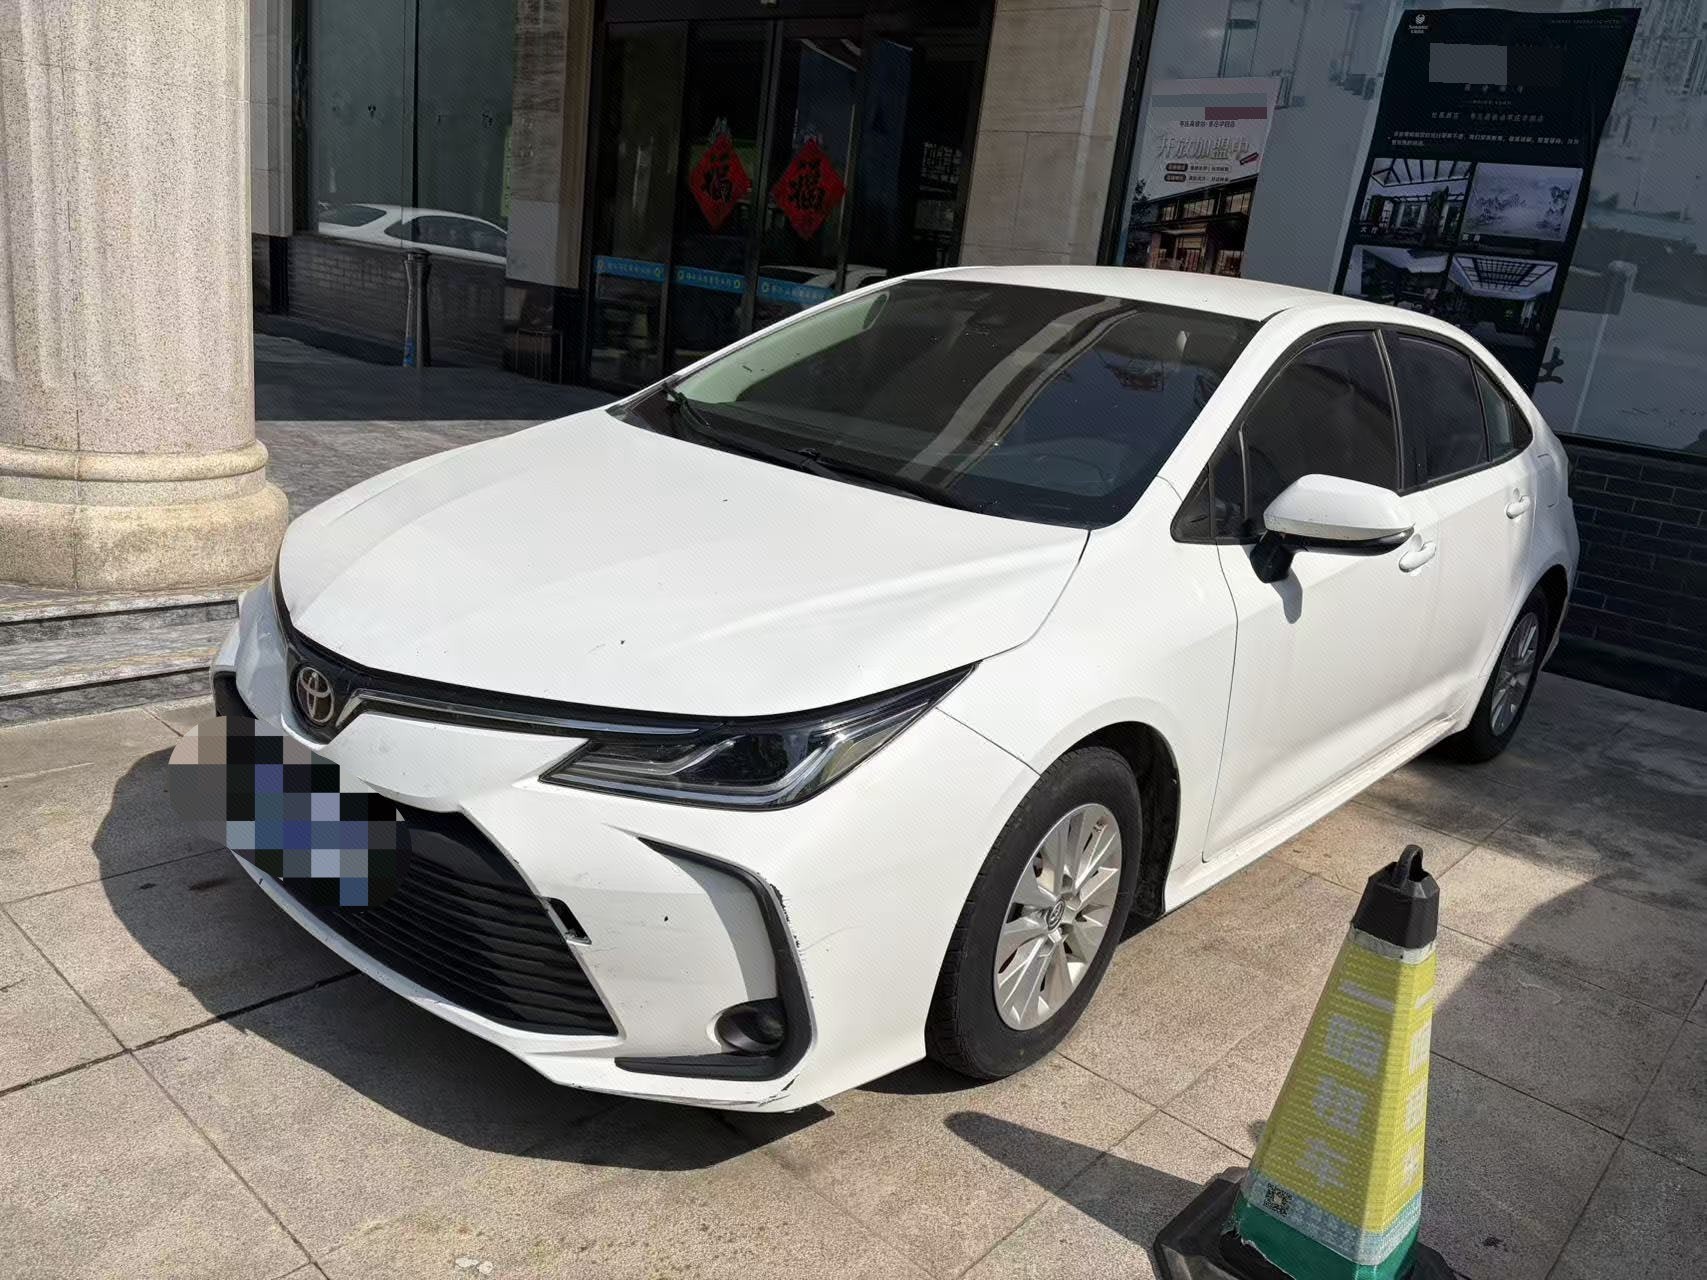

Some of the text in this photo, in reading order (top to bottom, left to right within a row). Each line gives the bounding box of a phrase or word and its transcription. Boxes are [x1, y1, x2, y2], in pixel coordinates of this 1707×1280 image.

[1156, 135, 1249, 160] 开放加盟中
[1297, 980, 1395, 1190] 一嗨租车
